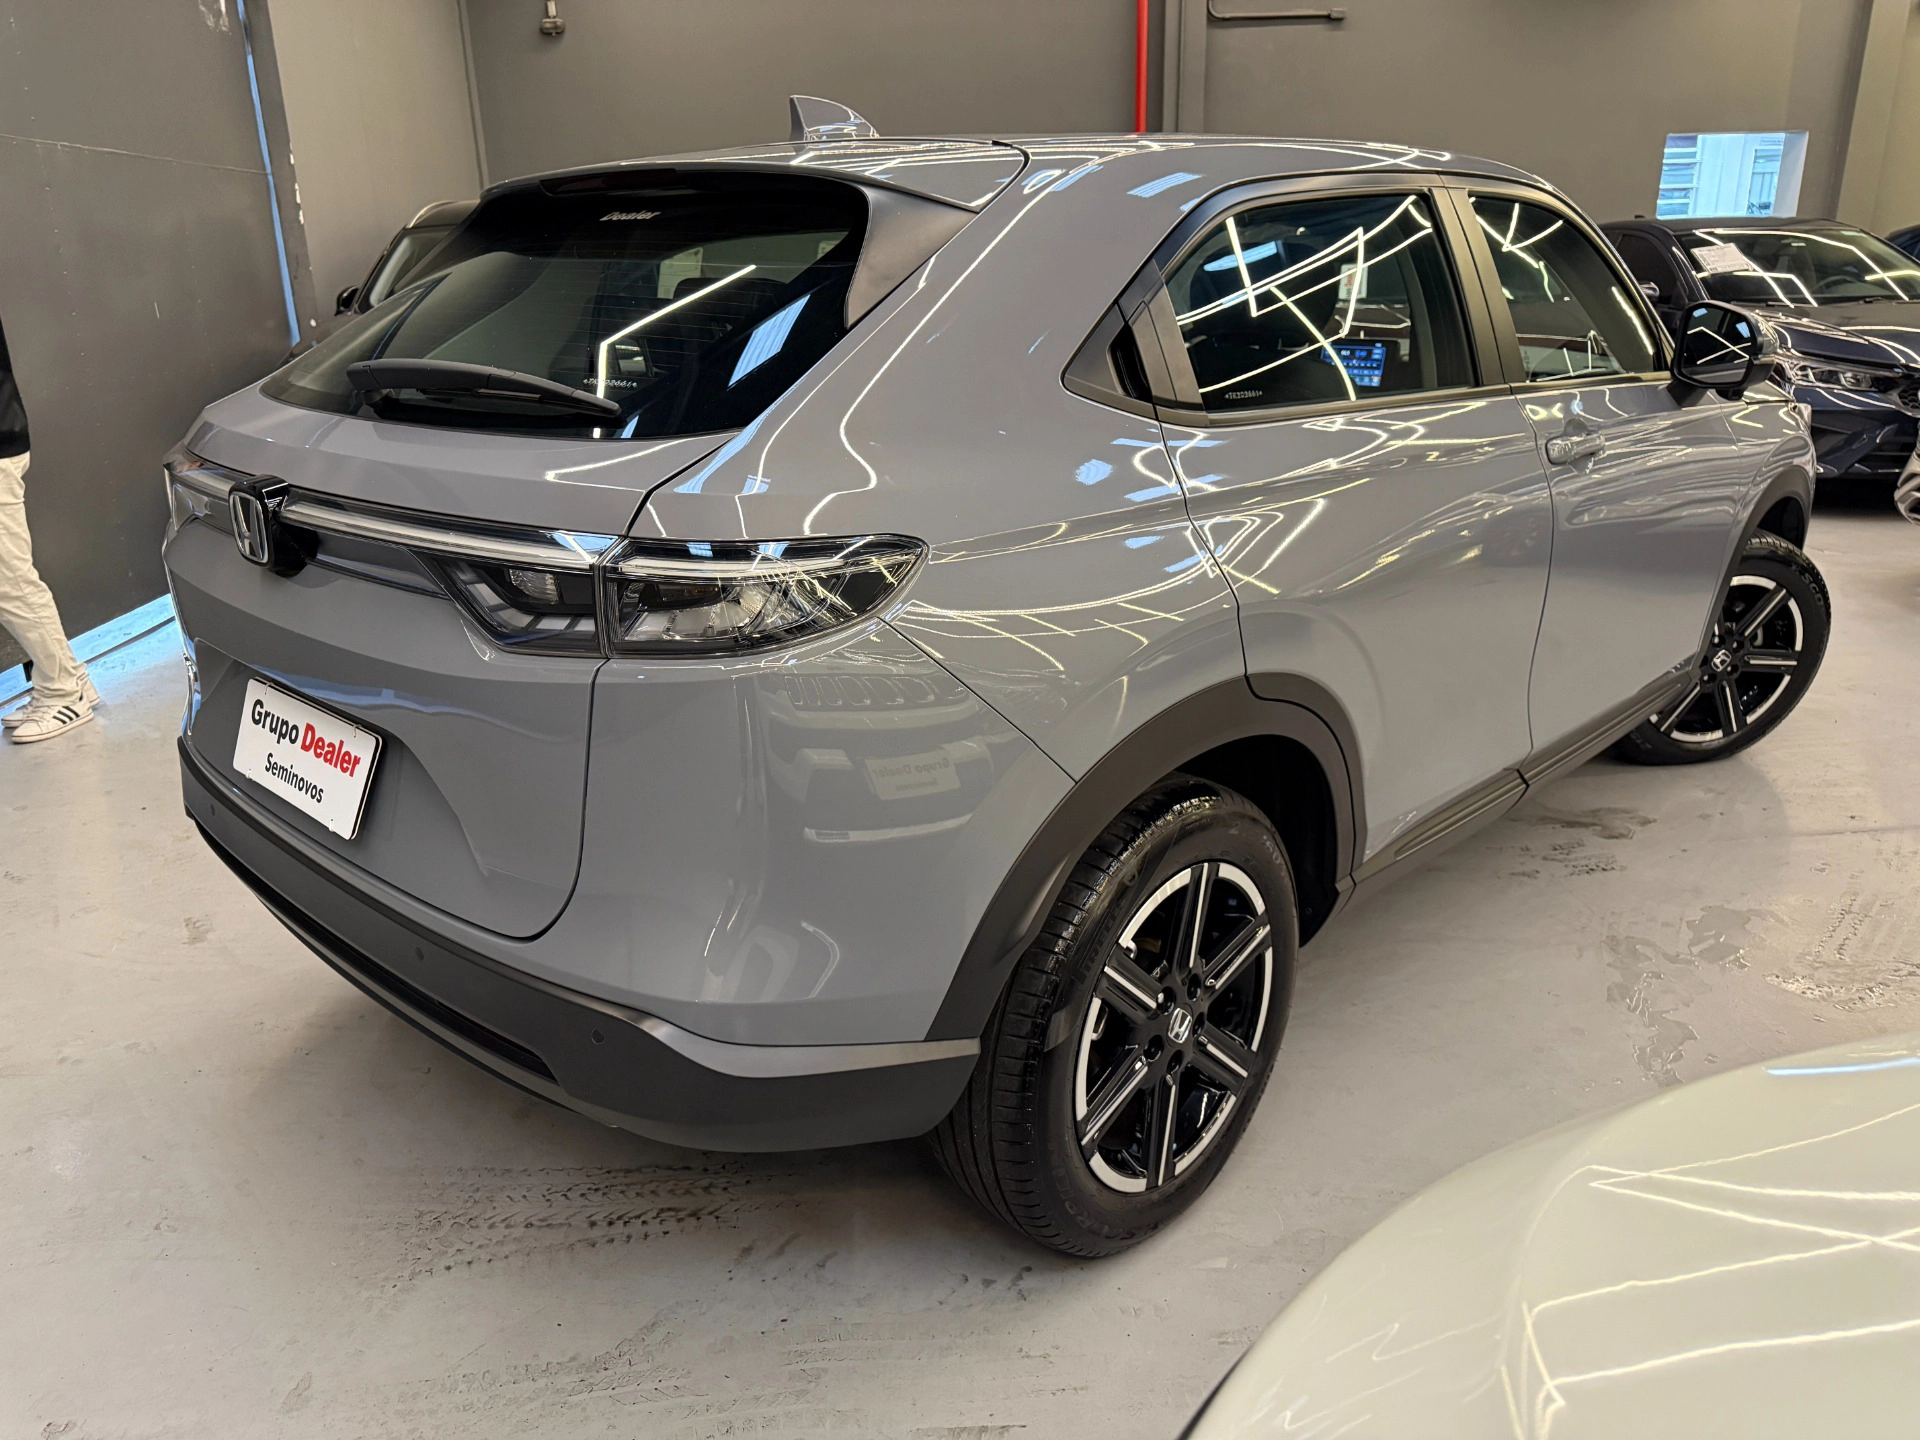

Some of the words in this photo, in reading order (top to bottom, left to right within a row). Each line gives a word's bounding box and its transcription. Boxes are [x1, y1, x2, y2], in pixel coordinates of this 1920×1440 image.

[251, 699, 300, 745] Grupo
[300, 722, 361, 777] Dealer
[265, 752, 324, 804] Seminovos
